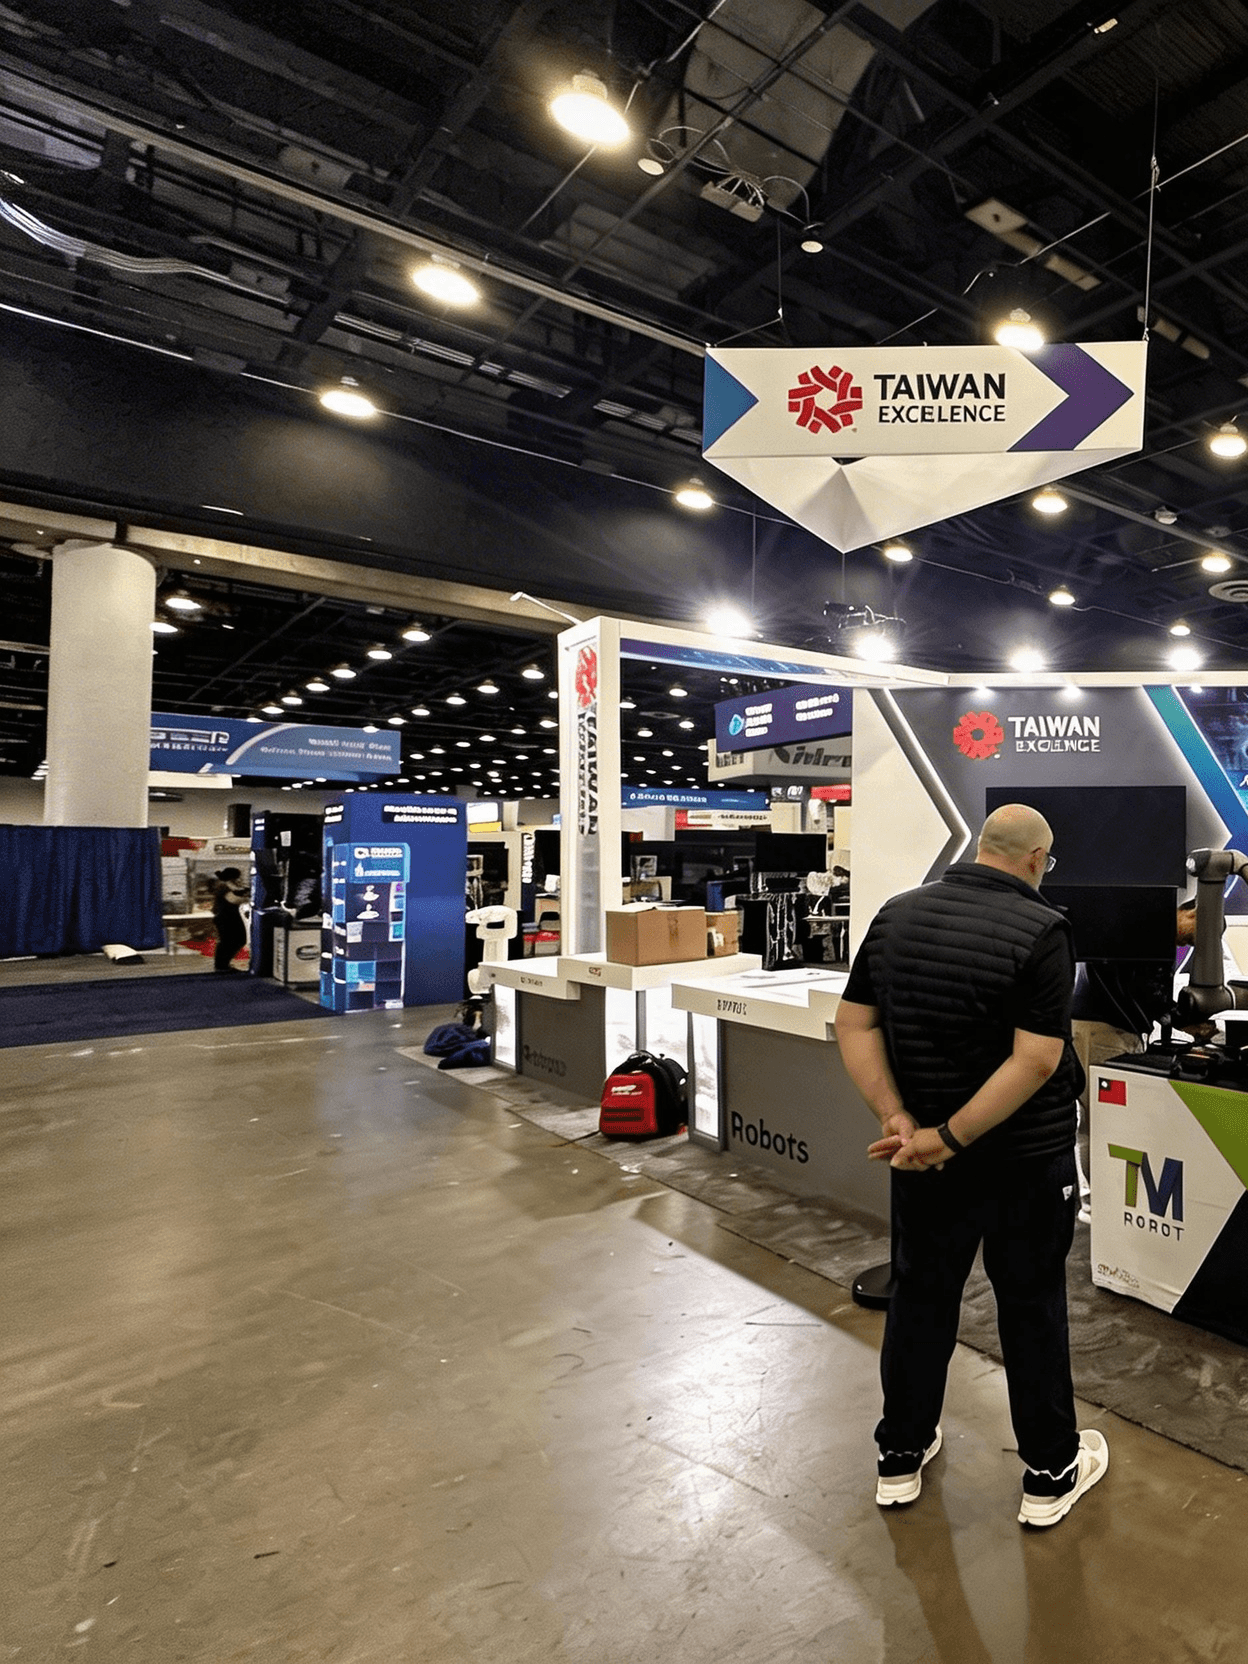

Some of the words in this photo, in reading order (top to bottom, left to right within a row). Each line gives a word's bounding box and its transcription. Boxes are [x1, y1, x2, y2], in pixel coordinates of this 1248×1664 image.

[873, 373, 1006, 400] TAIWAN
[1007, 715, 1100, 738] TAIWAN
[731, 1110, 809, 1164] Robots
[1107, 1143, 1184, 1223] TM
